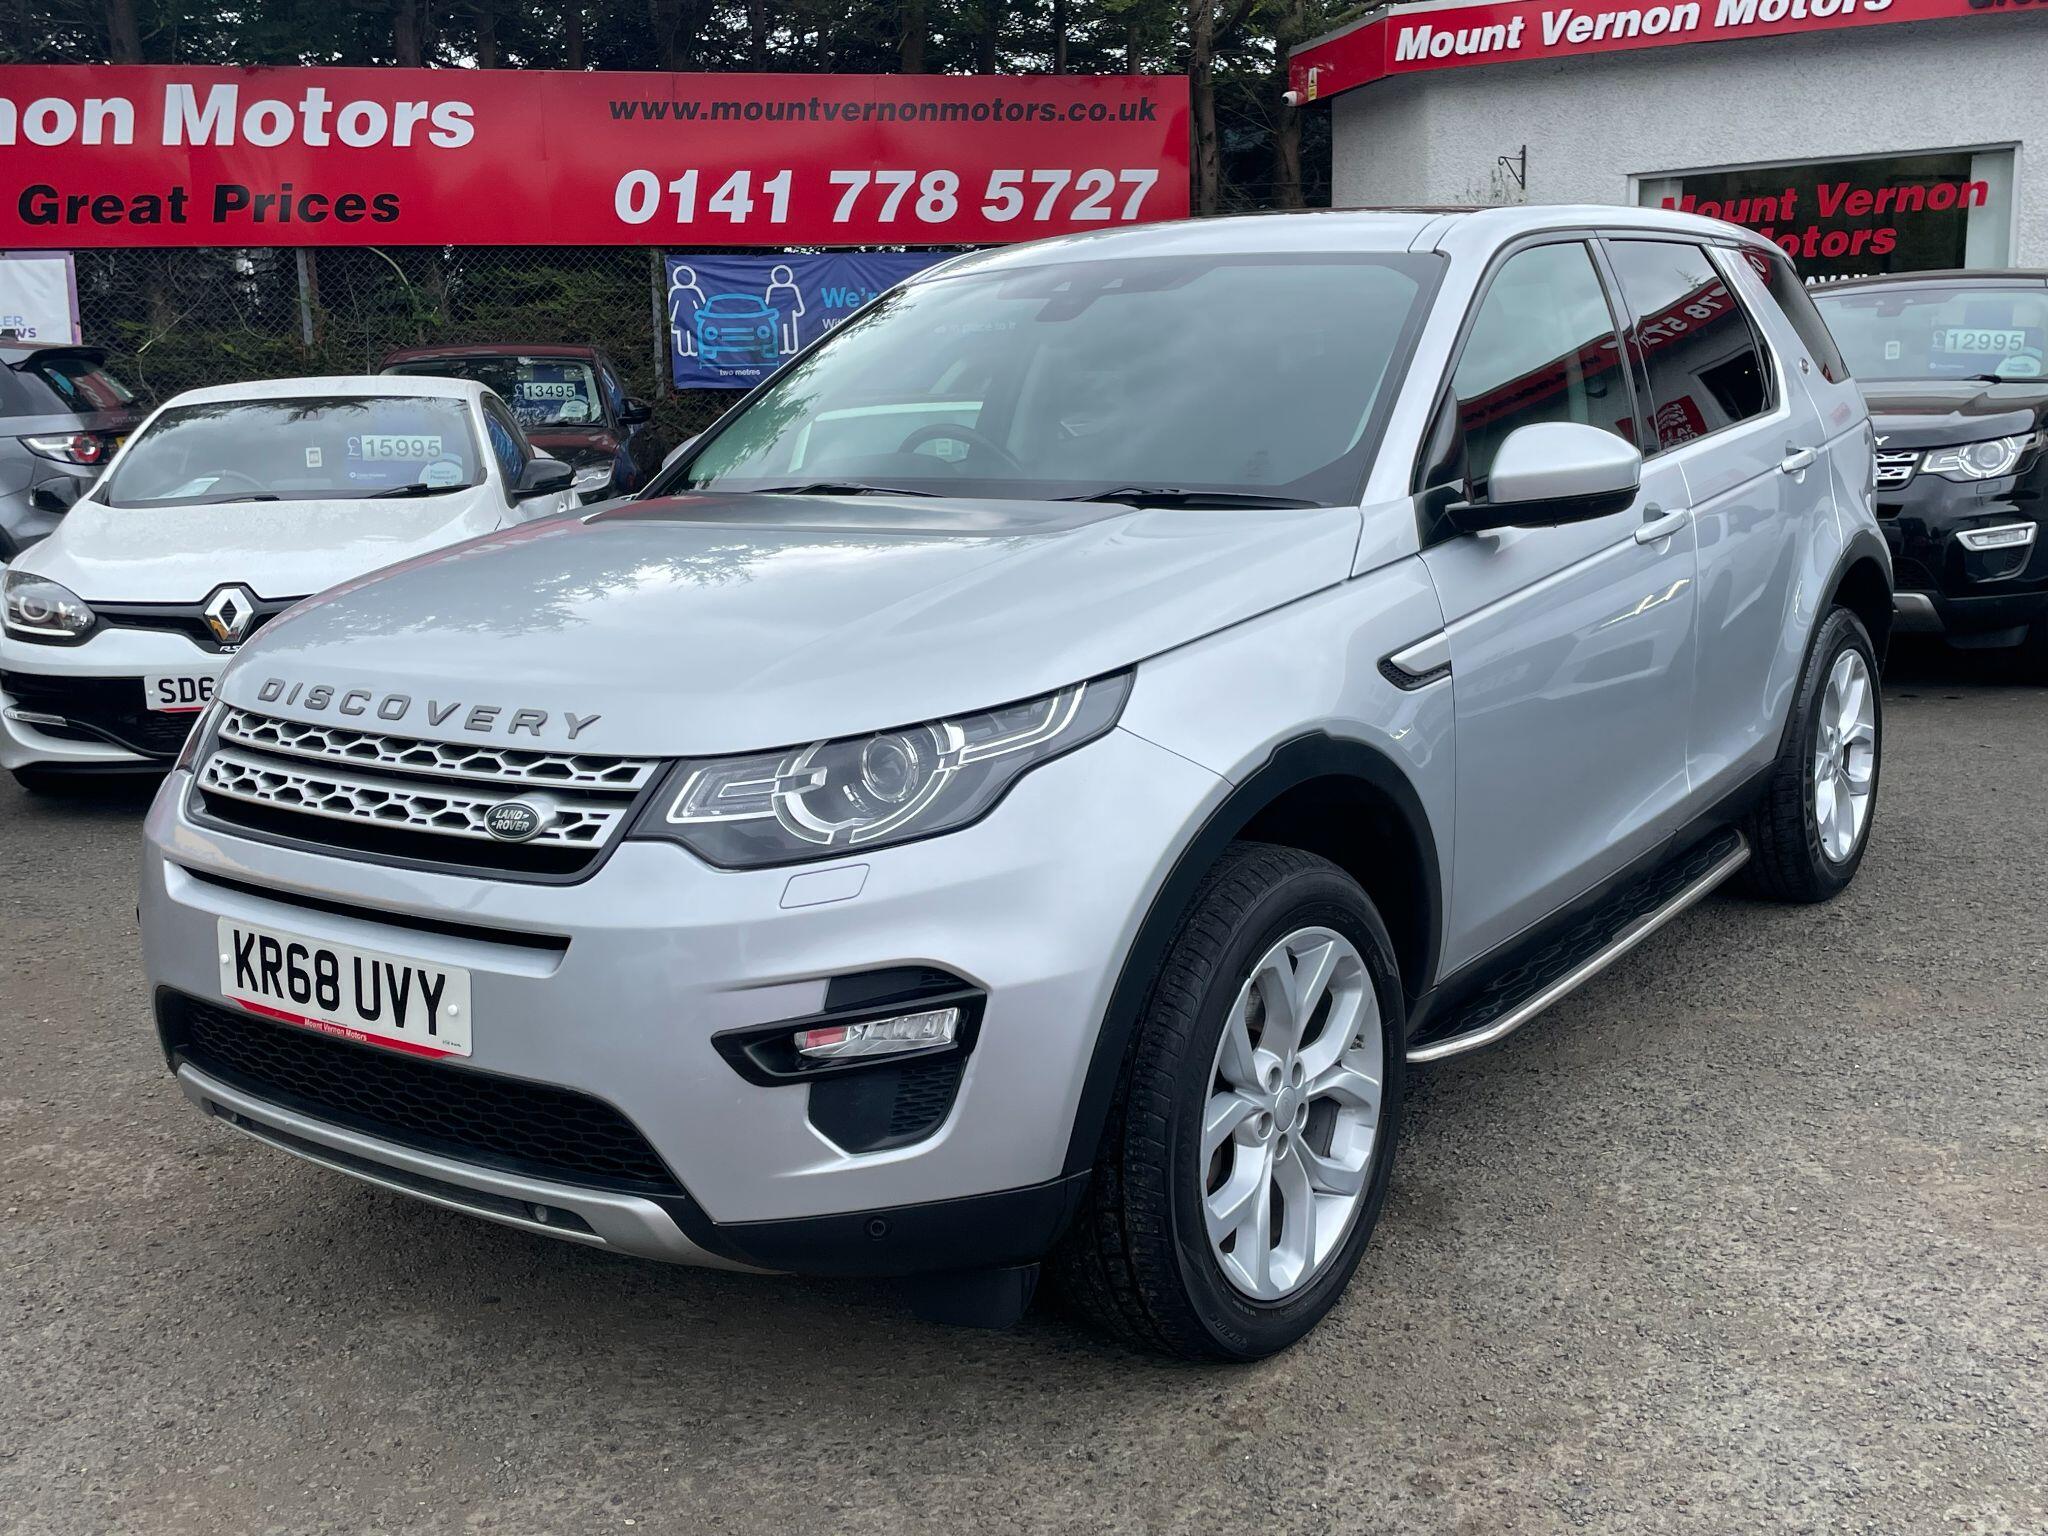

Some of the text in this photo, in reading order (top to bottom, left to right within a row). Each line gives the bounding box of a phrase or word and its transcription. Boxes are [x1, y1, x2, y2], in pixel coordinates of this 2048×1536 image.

[1395, 16, 1525, 61] Mount
[1541, 2, 1701, 46] Vernon
[162, 83, 475, 148] Motors
[608, 97, 1157, 121] www.mountvernonmotors.co.uk
[18, 183, 400, 225] Great Prices
[614, 168, 1159, 224] 0141 778 5727
[1817, 180, 1989, 218] Vernon
[1768, 225, 1897, 258] otors
[0, 316, 24, 326] ER
[1932, 330, 2022, 351] £12995
[719, 368, 761, 376] two metres
[347, 436, 440, 458] £15995
[158, 676, 215, 704] SD6
[257, 677, 602, 740] DISCOVERY
[495, 809, 524, 820] LAND
[495, 820, 530, 831] ROVER
[233, 929, 446, 1036] KR68 UVY
[304, 1018, 323, 1031] Mount
[323, 1022, 346, 1036] Vernon
[345, 1029, 368, 1042] Motors
